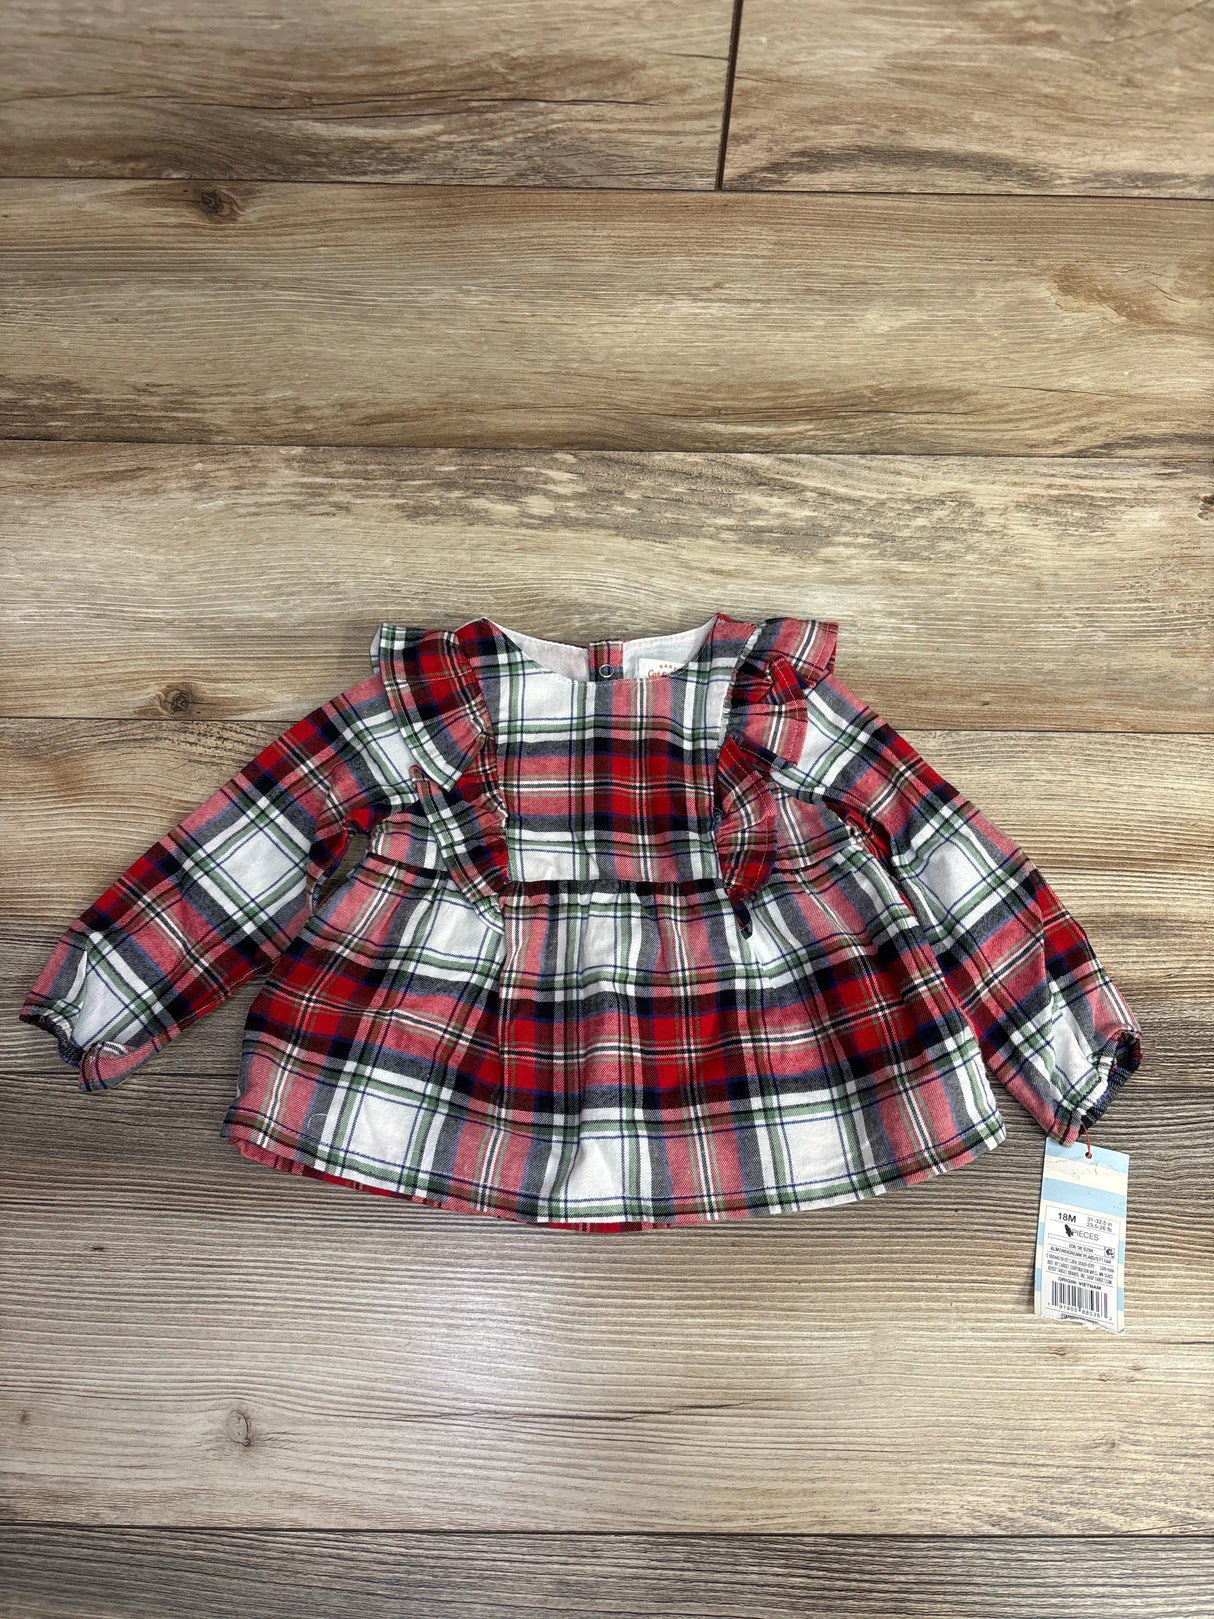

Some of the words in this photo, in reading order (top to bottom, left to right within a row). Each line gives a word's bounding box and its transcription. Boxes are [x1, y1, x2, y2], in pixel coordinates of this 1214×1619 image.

[1058, 1212, 1076, 1223] 18M
[1086, 1216, 1107, 1226] 31-32.5
[1086, 1222, 1106, 1231] 23.5-26
[1072, 1228, 1099, 1241] PIECES
[1058, 1276, 1077, 1285] ORIGIN:
[1078, 1281, 1102, 1290] VIETNAM
